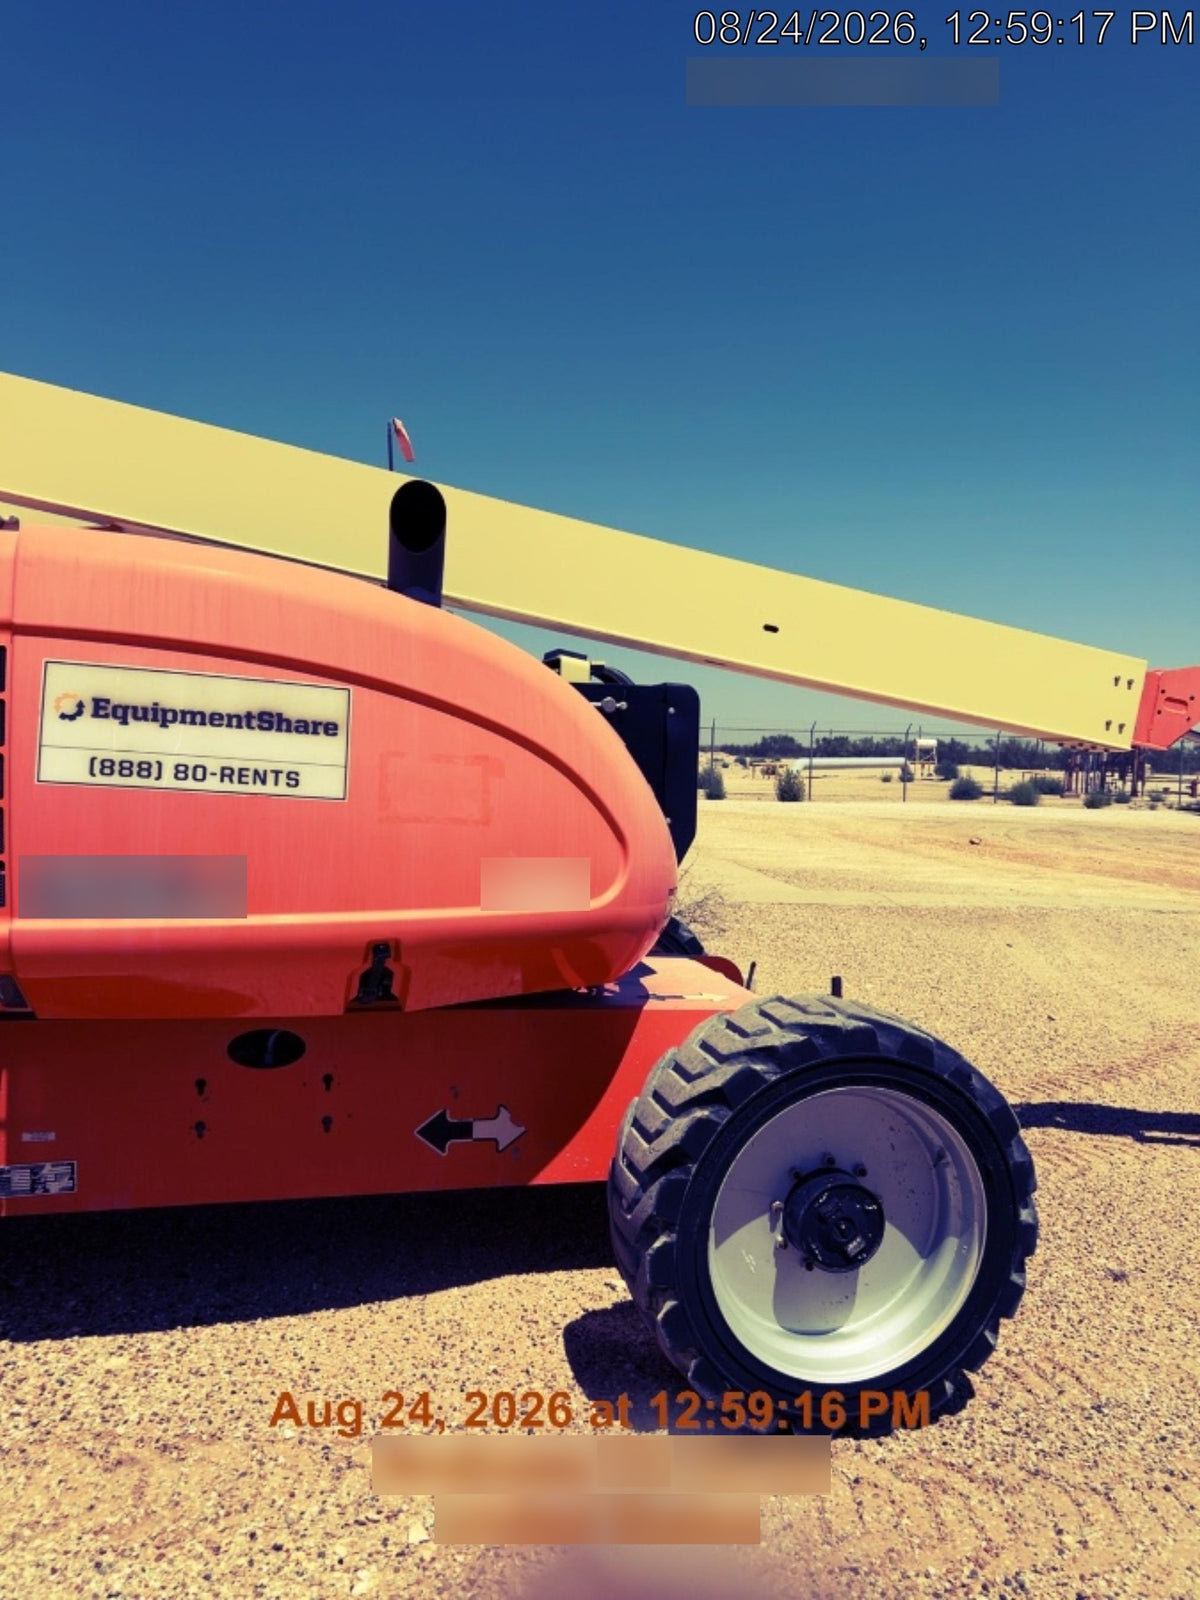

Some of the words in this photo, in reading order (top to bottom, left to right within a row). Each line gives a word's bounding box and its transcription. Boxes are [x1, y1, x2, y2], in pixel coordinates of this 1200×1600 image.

[90, 697, 339, 737] EquipmentShare
[89, 756, 163, 780] (888)
[173, 763, 300, 788] 80-RENTS
